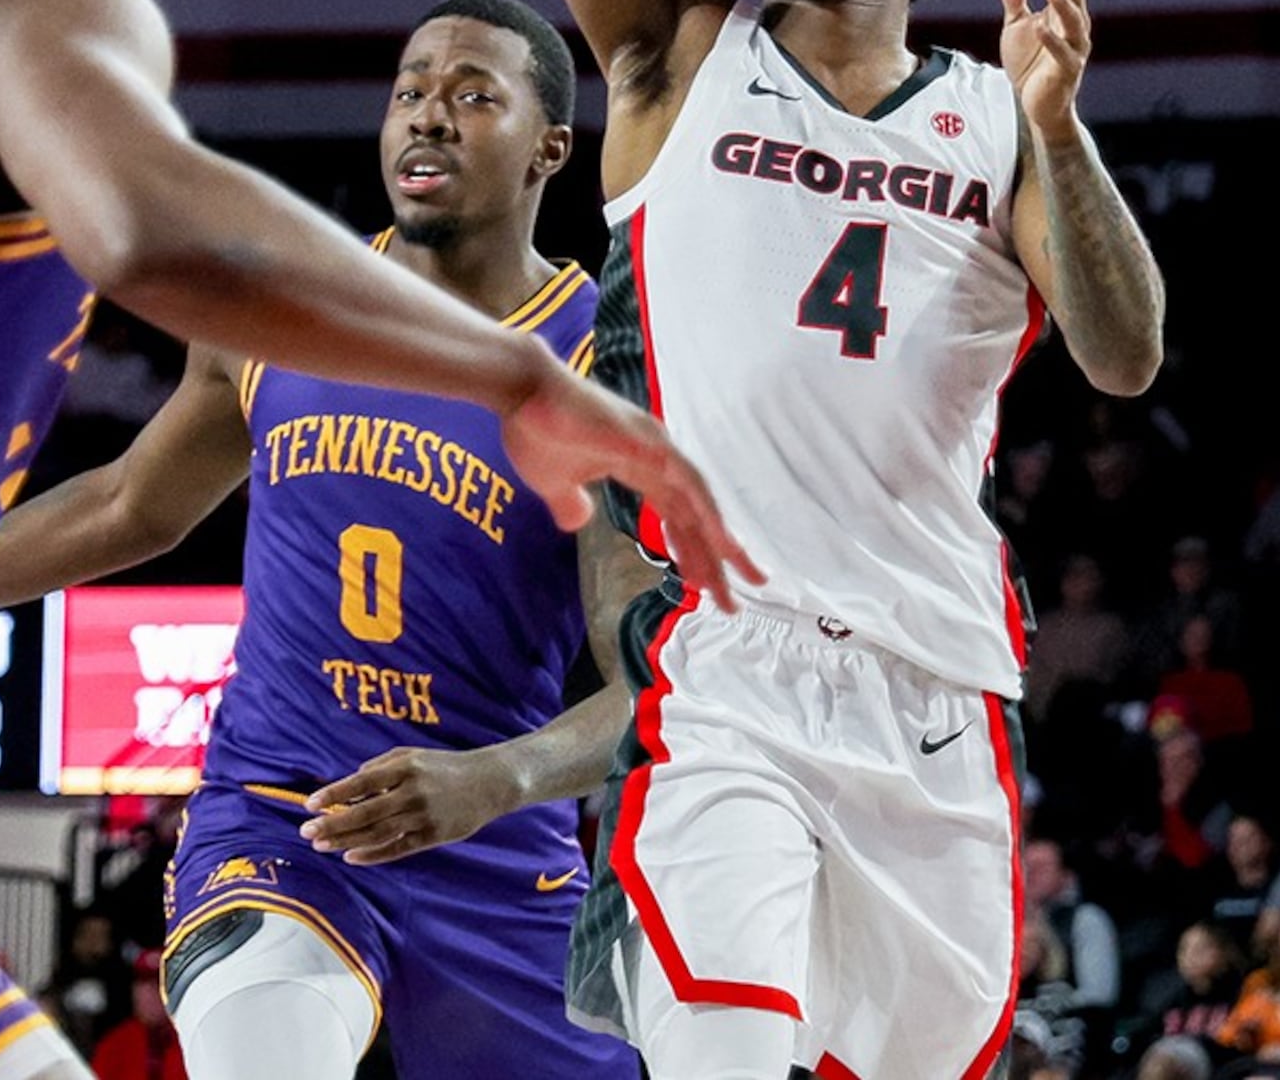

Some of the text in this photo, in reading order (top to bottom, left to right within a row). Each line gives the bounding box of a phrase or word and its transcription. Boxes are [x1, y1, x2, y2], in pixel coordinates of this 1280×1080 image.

[932, 112, 963, 137] SEC
[711, 131, 991, 228] GEORGIA
[796, 220, 889, 360] 4
[266, 414, 516, 546] TENNESSEE
[338, 523, 404, 645] 0
[322, 659, 440, 725] TECH
